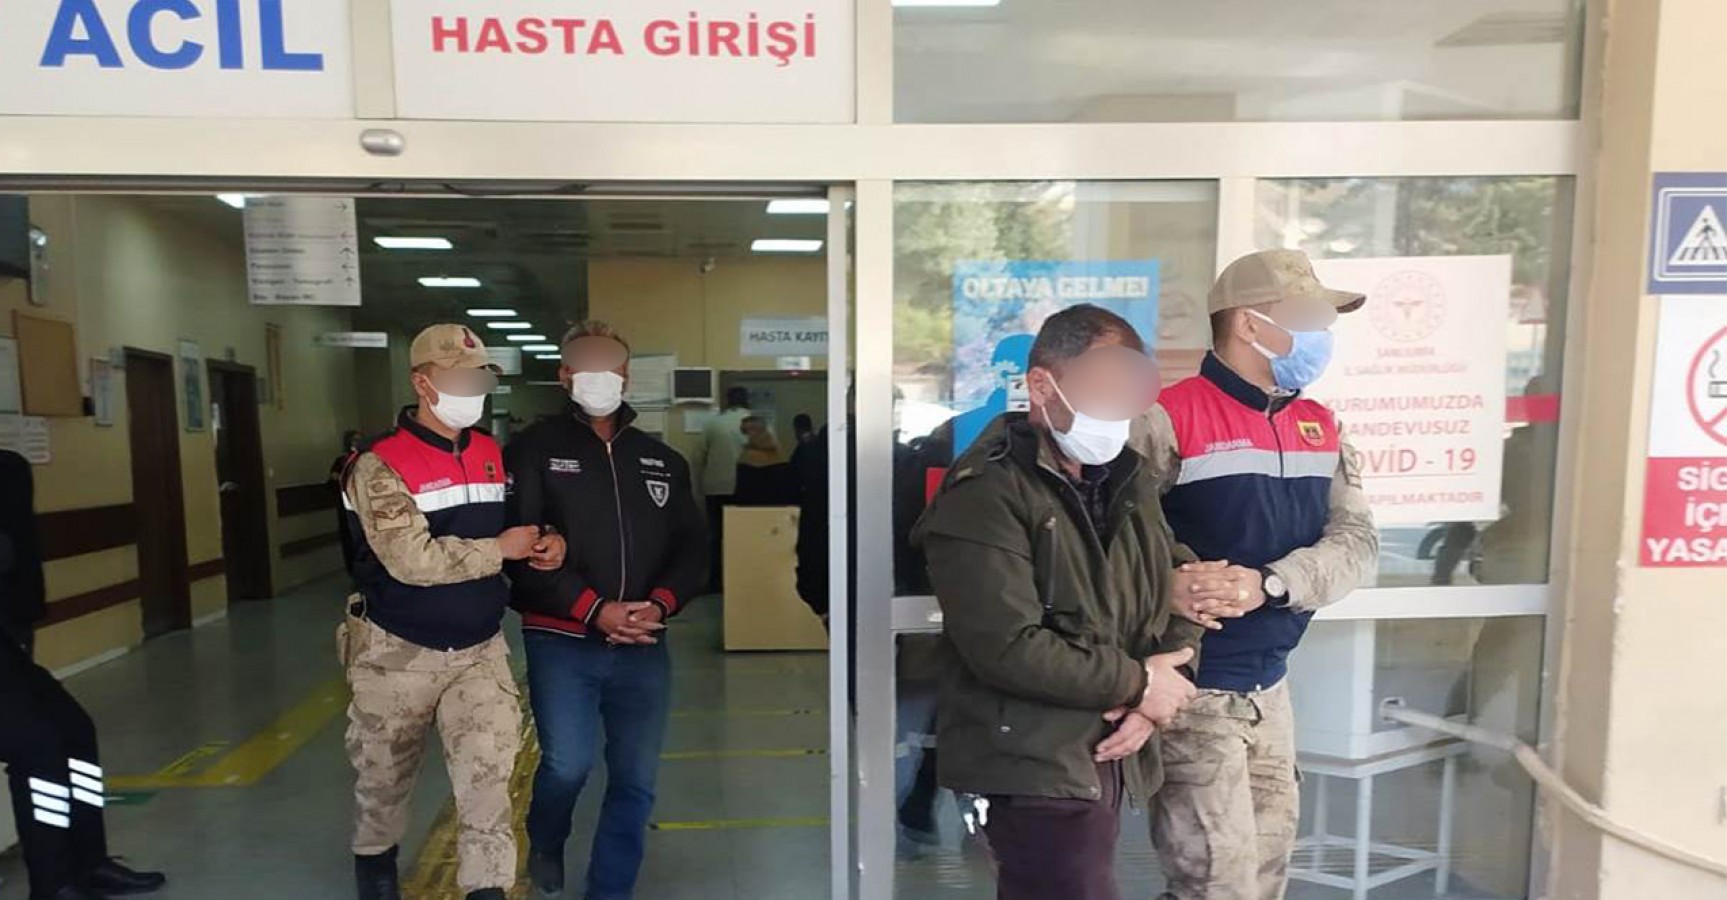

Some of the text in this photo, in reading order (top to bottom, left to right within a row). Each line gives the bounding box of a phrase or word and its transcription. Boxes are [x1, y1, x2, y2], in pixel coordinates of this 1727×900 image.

[431, 11, 817, 68] HASTA GİRİŞİ
[963, 276, 1053, 299] OLTAYA
[749, 330, 792, 343] HASTA
[1350, 419, 1471, 437] ANDEVUSUZ
[1444, 448, 1476, 472] 19
[1368, 491, 1484, 506] APILMAKTADIR
